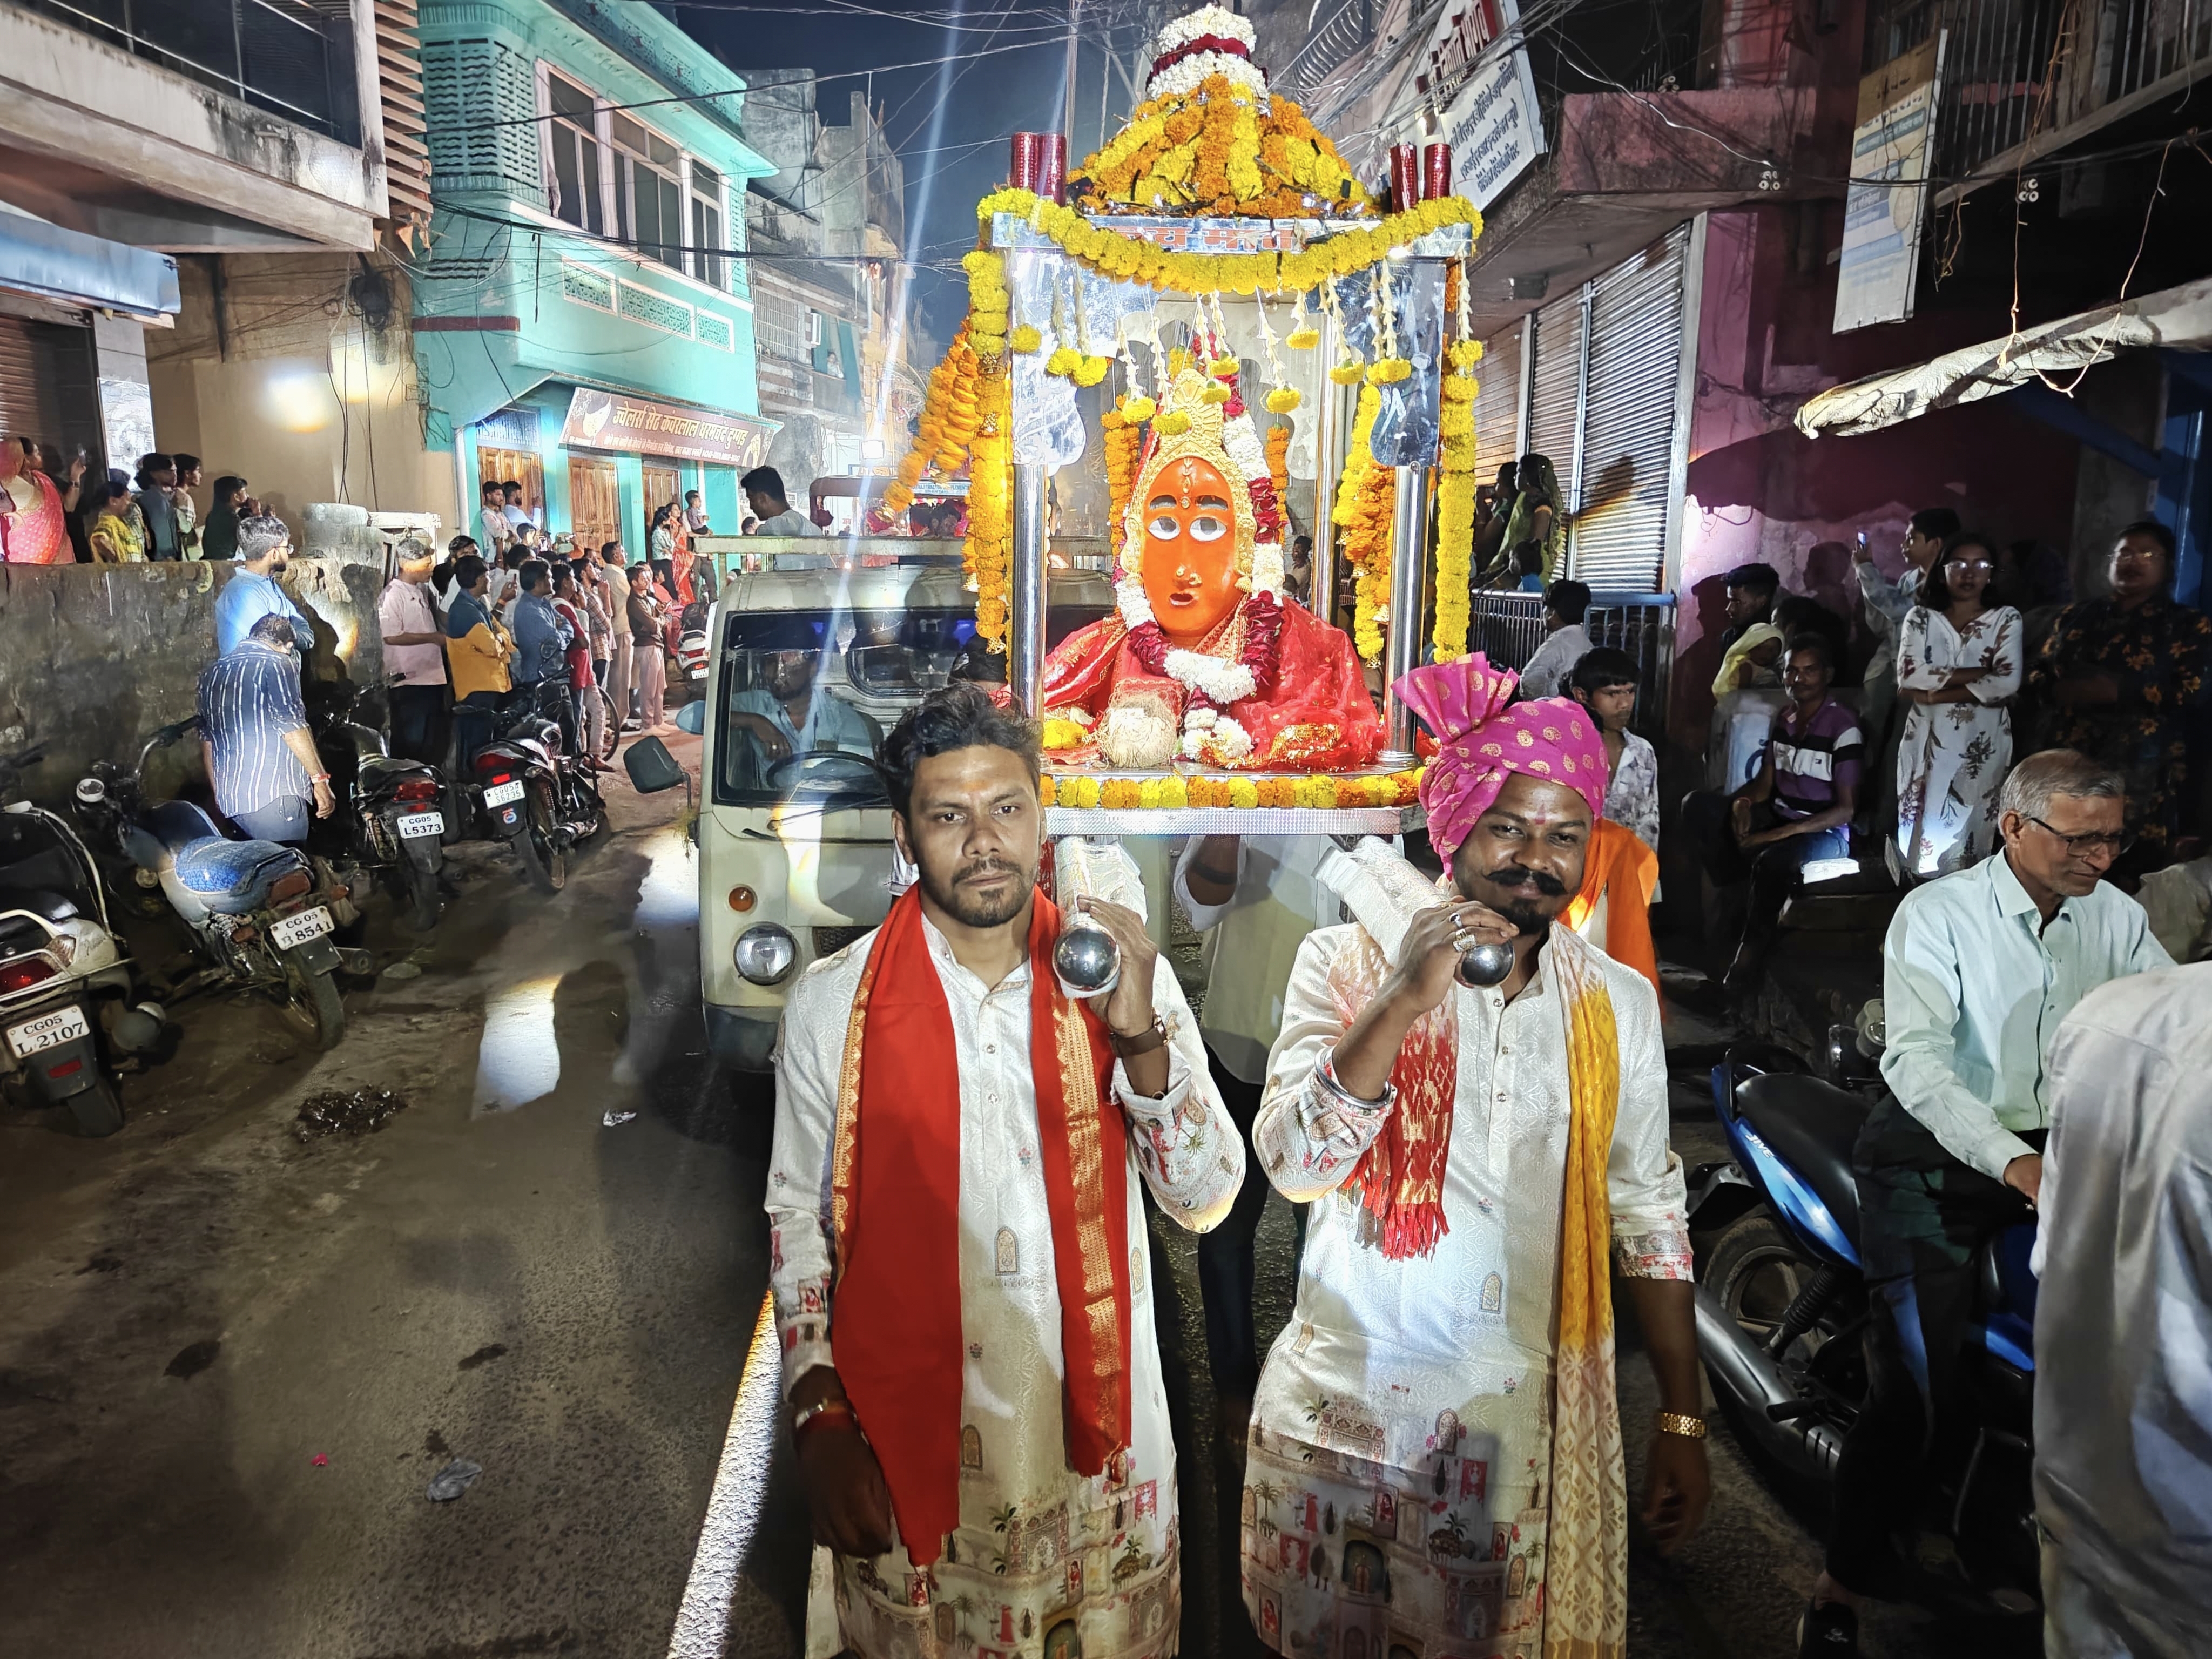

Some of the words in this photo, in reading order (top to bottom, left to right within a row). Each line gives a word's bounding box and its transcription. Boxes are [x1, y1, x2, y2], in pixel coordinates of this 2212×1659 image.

[645, 406, 663, 431] सेठ
[404, 824, 441, 835] L5373
[409, 816, 431, 824] CG05
[24, 1015, 63, 1035] CG05
[1745, 1134, 1775, 1158] JIVE
